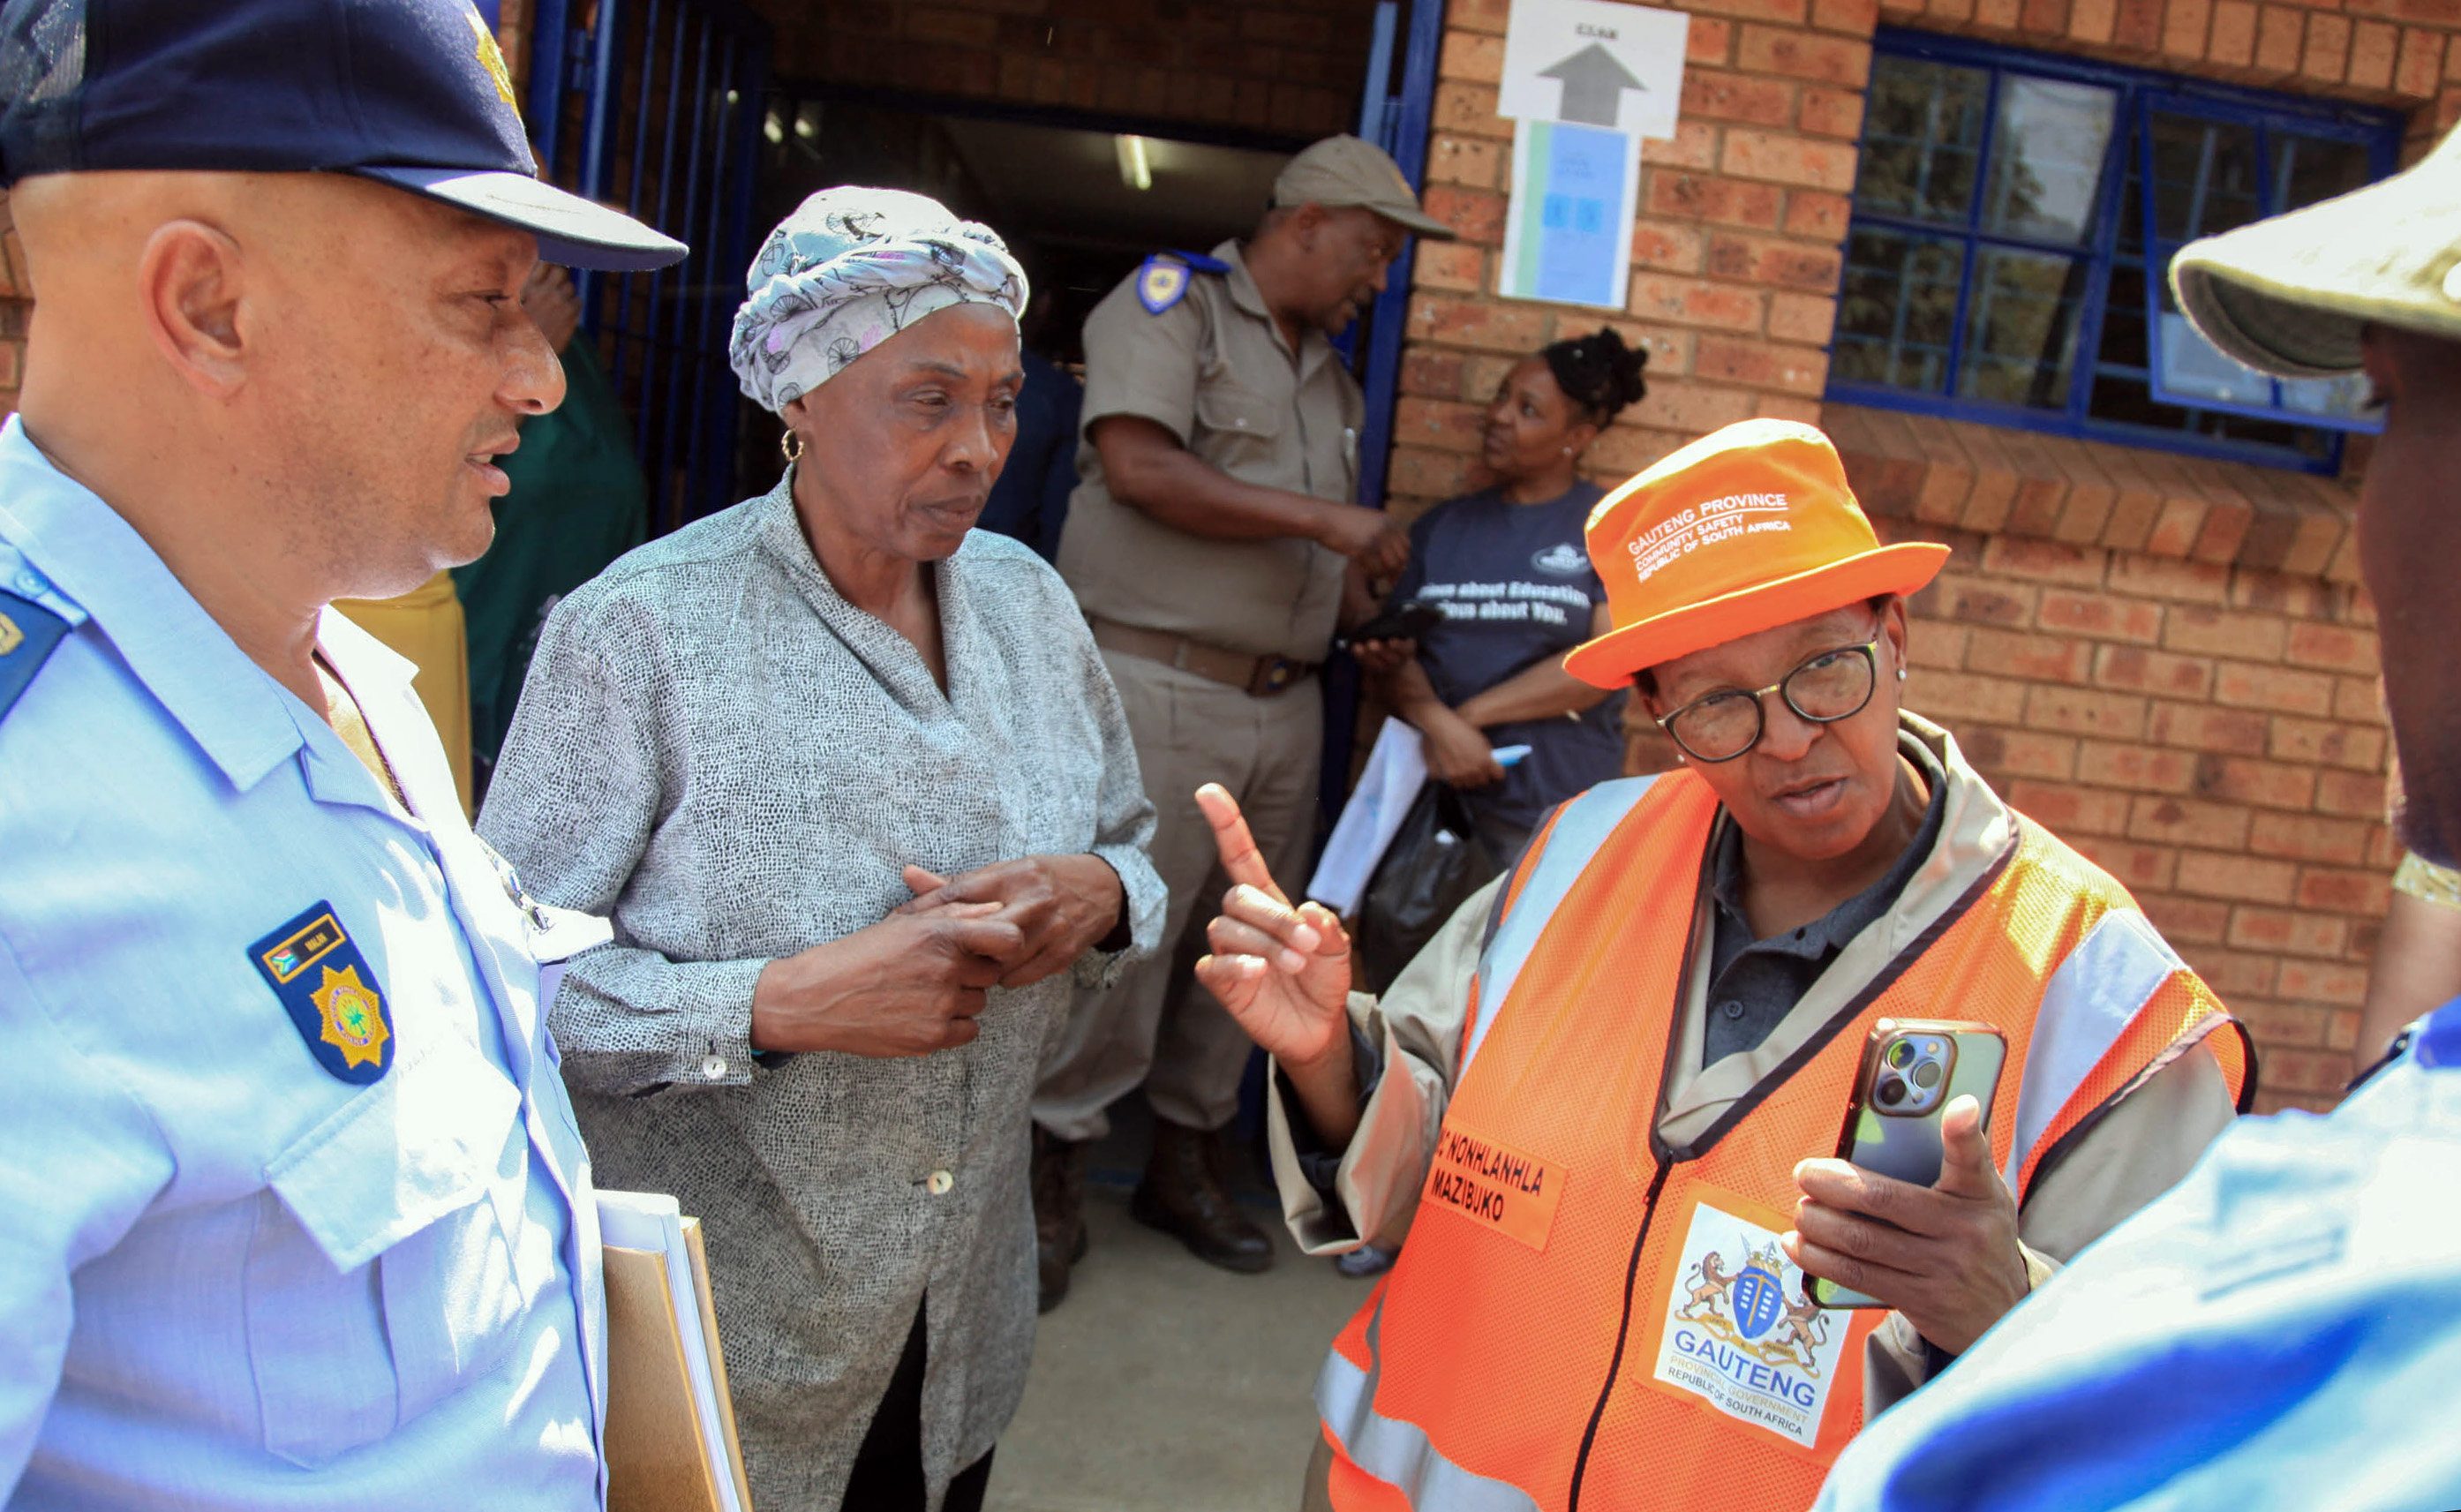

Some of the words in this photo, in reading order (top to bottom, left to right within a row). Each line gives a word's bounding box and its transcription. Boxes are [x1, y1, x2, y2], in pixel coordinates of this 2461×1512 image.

[1628, 508, 1696, 555] GAUTENG
[1700, 493, 1787, 515] PROVINCE
[1636, 530, 1694, 571] COMMUNITY
[1697, 514, 1743, 535] SAFETY
[1638, 549, 1681, 583] REPUBLIC
[1683, 539, 1698, 553] OF
[1702, 526, 1744, 545] SOUTH
[1747, 520, 1791, 534] AFRICA
[1457, 582, 1507, 599] about
[1479, 600, 1529, 619] about
[1432, 1168, 1504, 1222] MAZIBUKO
[1447, 1132, 1543, 1197] NONHLANHLA
[1670, 1355, 1725, 1389] PROVINCIAL
[1728, 1386, 1809, 1425] GOVERNMENT
[1675, 1330, 1815, 1407] GAUTENG
[1668, 1366, 1715, 1394] REPUBLIC
[1714, 1388, 1725, 1402] OF
[1725, 1396, 1763, 1418] SOUTH
[1764, 1410, 1802, 1436] AFRICA
